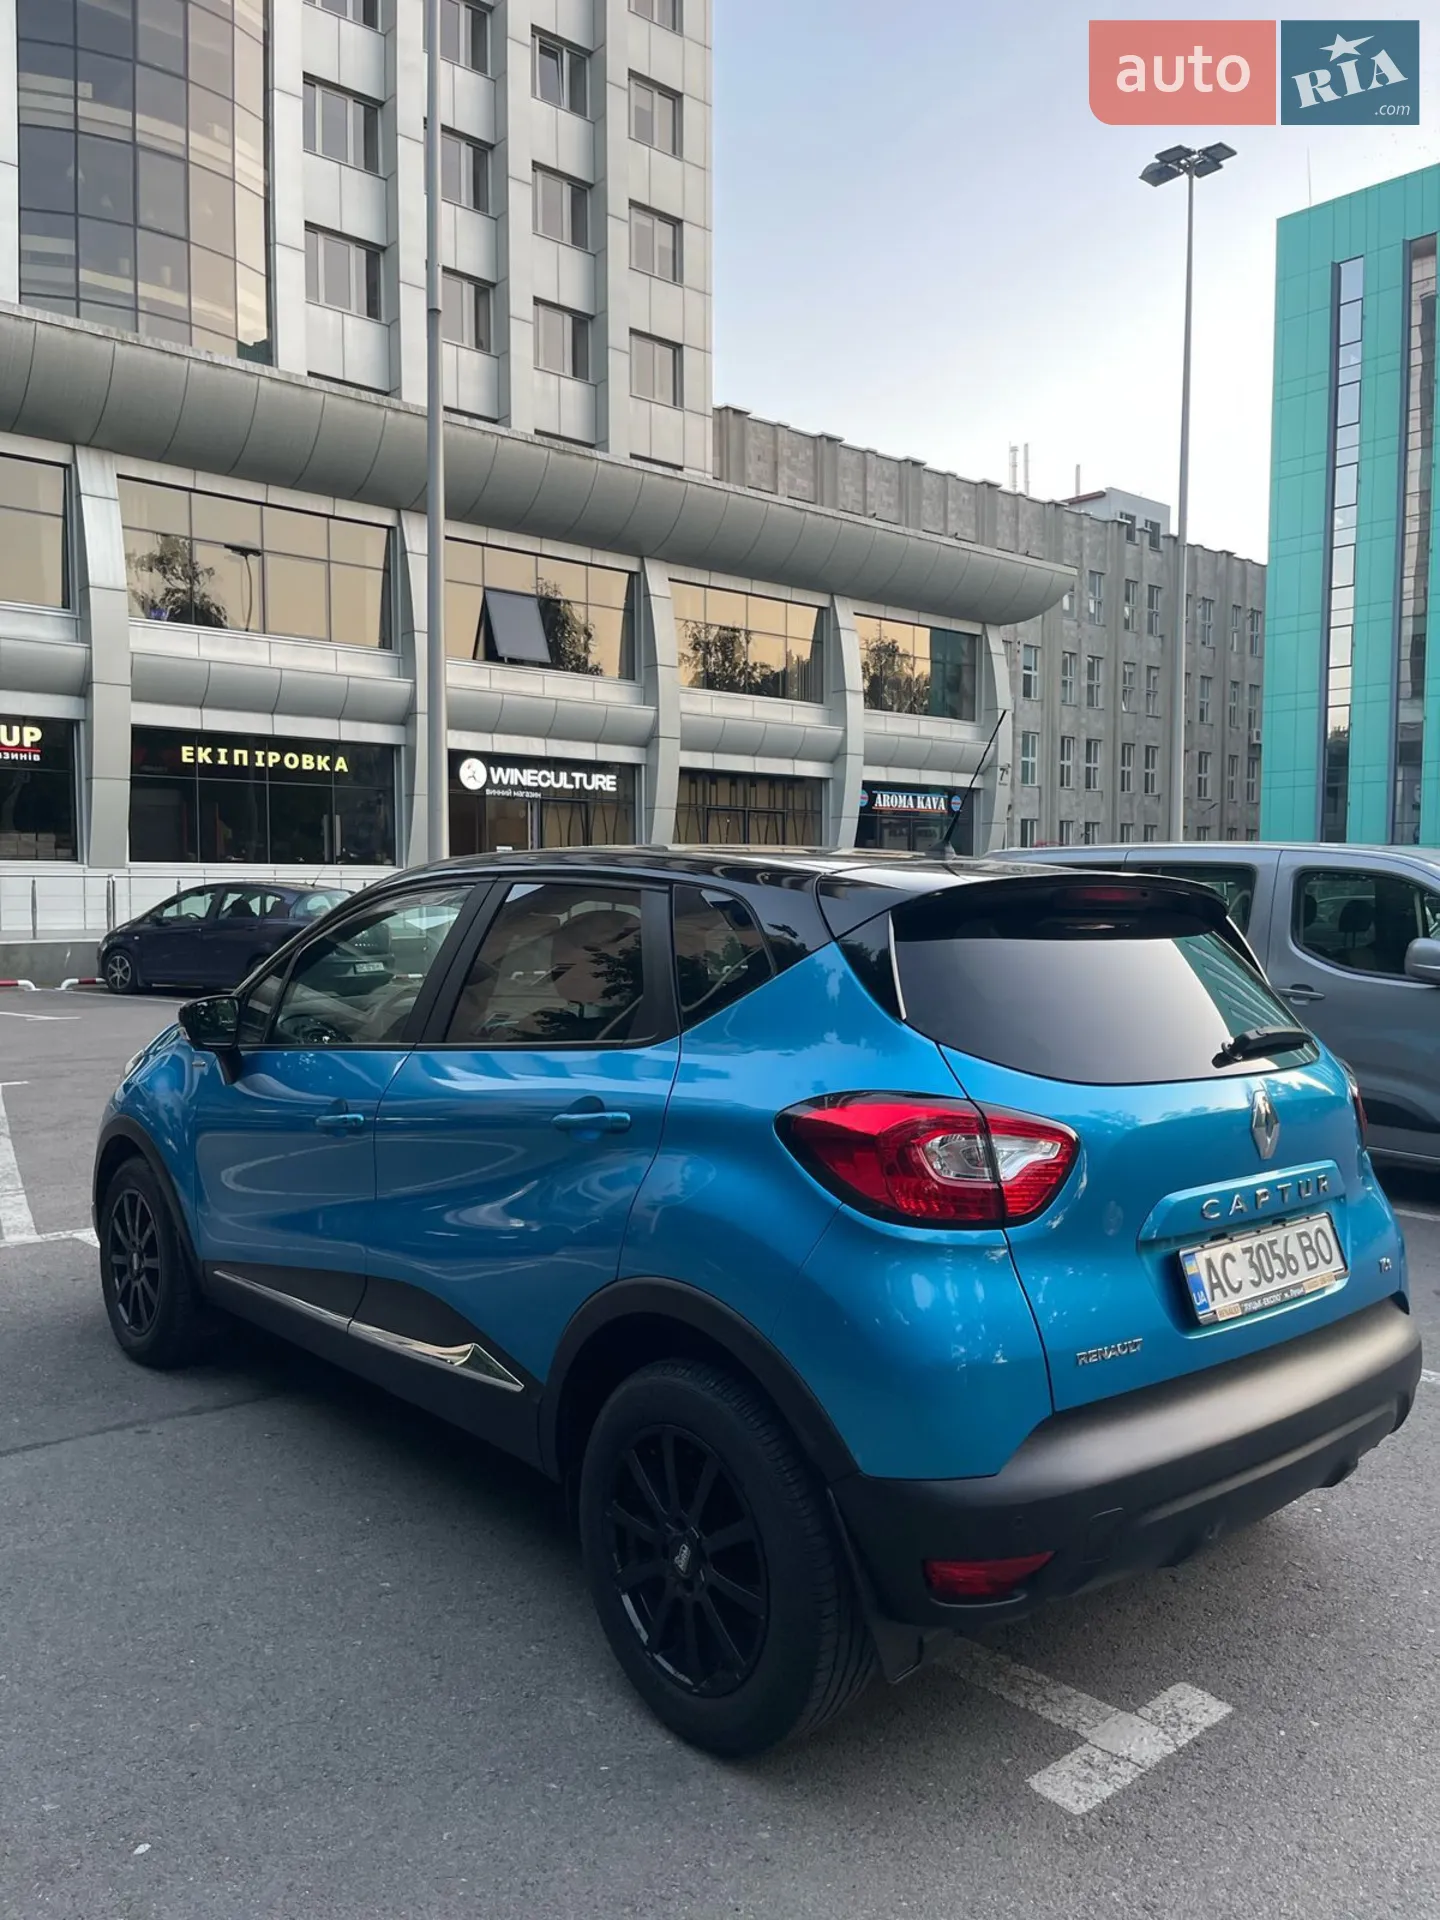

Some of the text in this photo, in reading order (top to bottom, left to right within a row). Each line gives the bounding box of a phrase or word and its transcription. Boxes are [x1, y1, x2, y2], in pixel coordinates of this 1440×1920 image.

[181, 746, 348, 772] ЕКІПІРОВКА
[490, 767, 617, 791] WINECULTURE
[875, 793, 946, 811] AROMA KAVA
[1202, 1174, 1329, 1219] CAPTUR
[1204, 1253, 1243, 1301] AC
[1241, 1235, 1299, 1288] 3056
[1296, 1227, 1333, 1271] BO
[1193, 1291, 1208, 1306] UA
[1076, 1338, 1143, 1366] RENAULT
